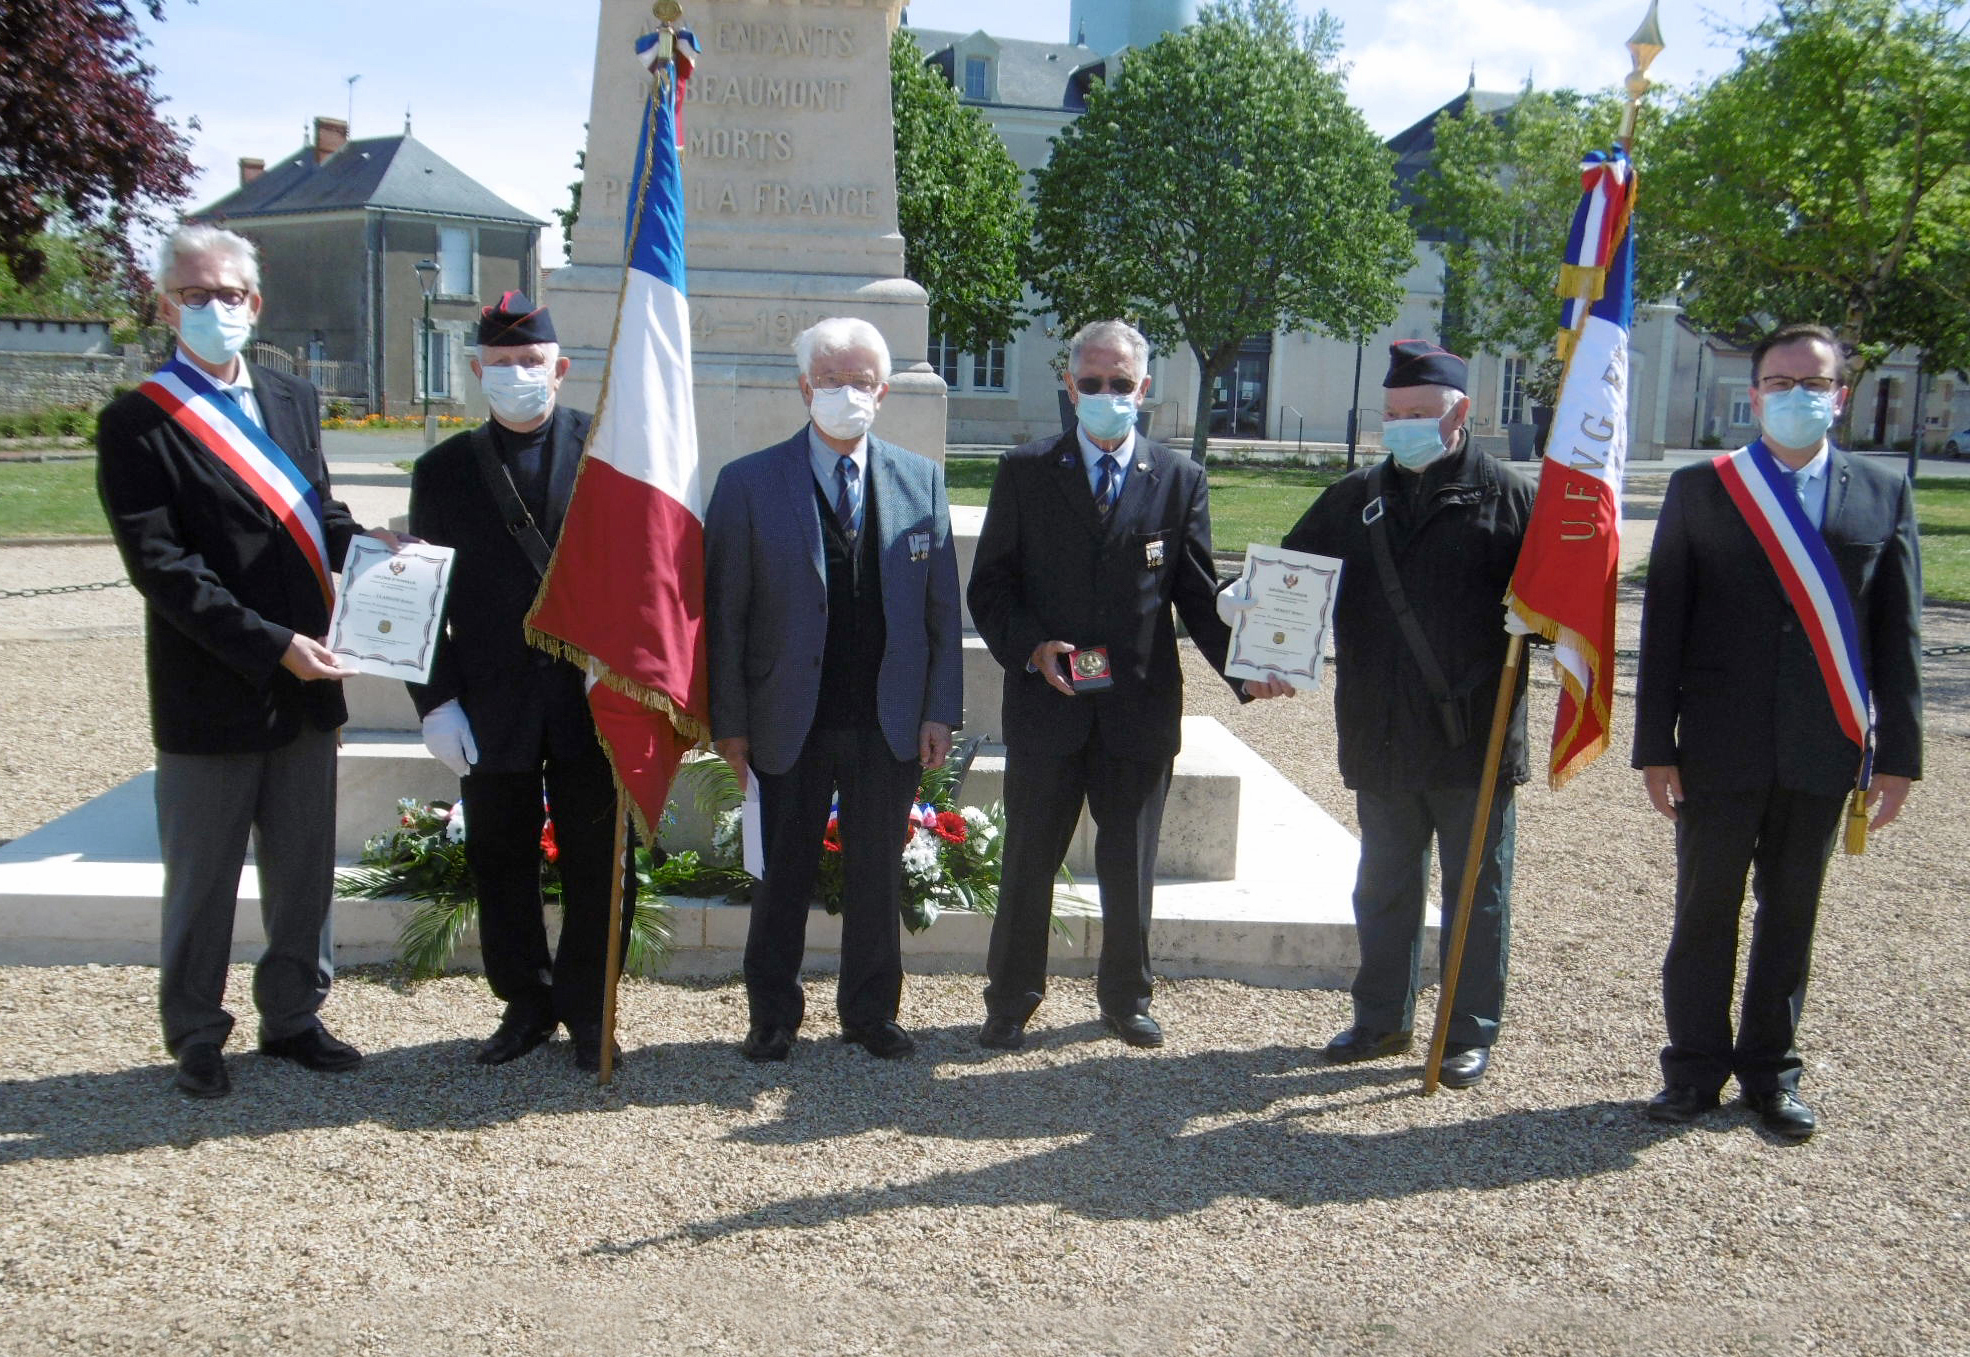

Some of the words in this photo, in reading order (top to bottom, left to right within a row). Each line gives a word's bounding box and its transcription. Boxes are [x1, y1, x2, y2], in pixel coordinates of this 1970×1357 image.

[715, 22, 855, 58] ENFANTS
[684, 74, 848, 110] BEAUMONT
[689, 128, 794, 162] MORTS
[755, 183, 878, 218] FRANCE
